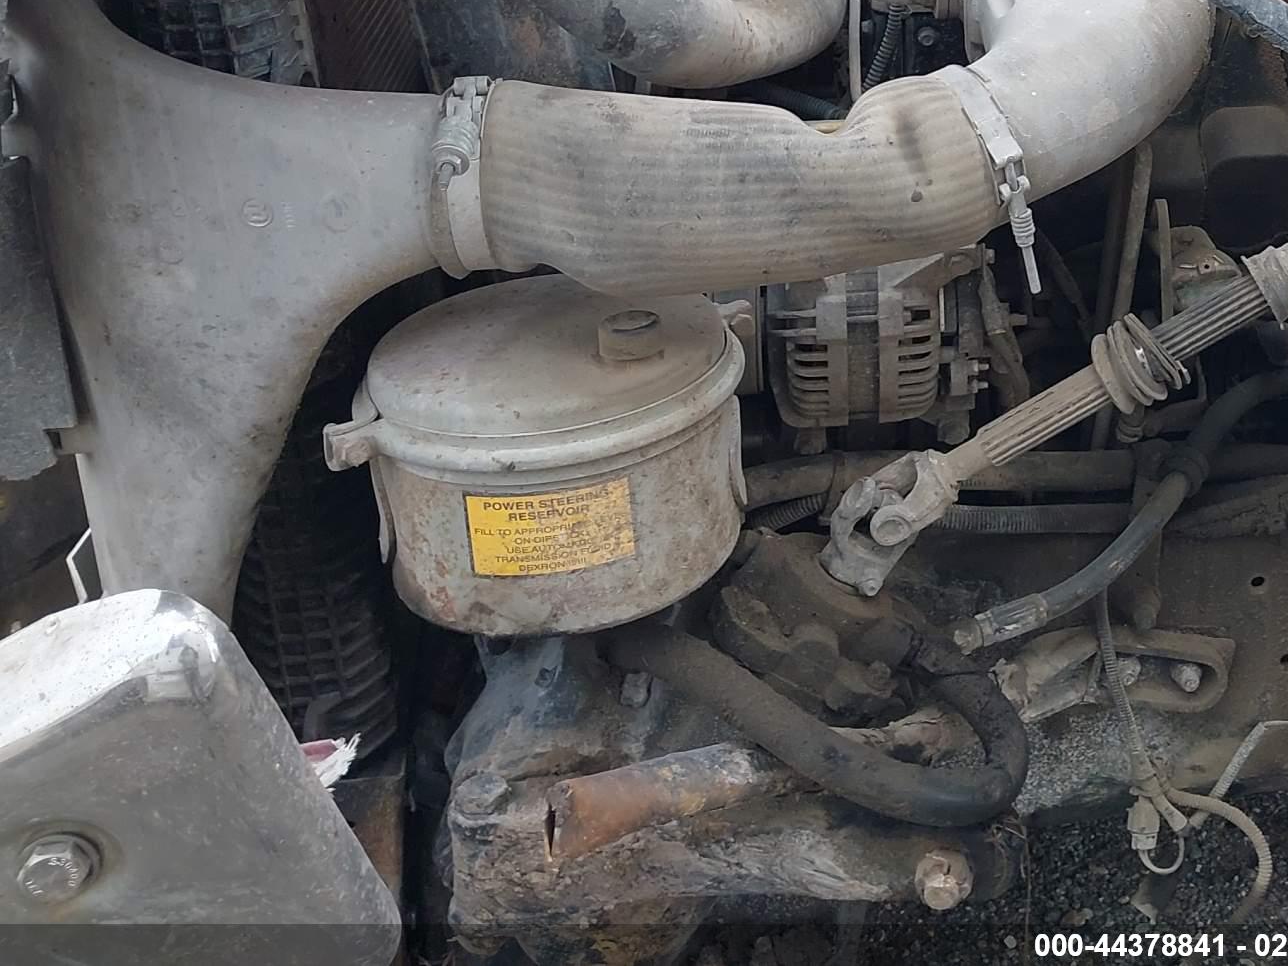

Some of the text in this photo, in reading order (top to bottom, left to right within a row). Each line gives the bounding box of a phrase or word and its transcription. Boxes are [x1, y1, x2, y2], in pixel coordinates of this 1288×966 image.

[483, 501, 534, 512] POWER
[508, 504, 590, 522] RESERVOIR
[474, 527, 495, 536] FILL
[496, 528, 512, 536] TO
[514, 537, 531, 545] ON
[506, 545, 530, 554] USE
[495, 549, 578, 563] TRANSMISSION
[518, 560, 566, 572] DEXRON
